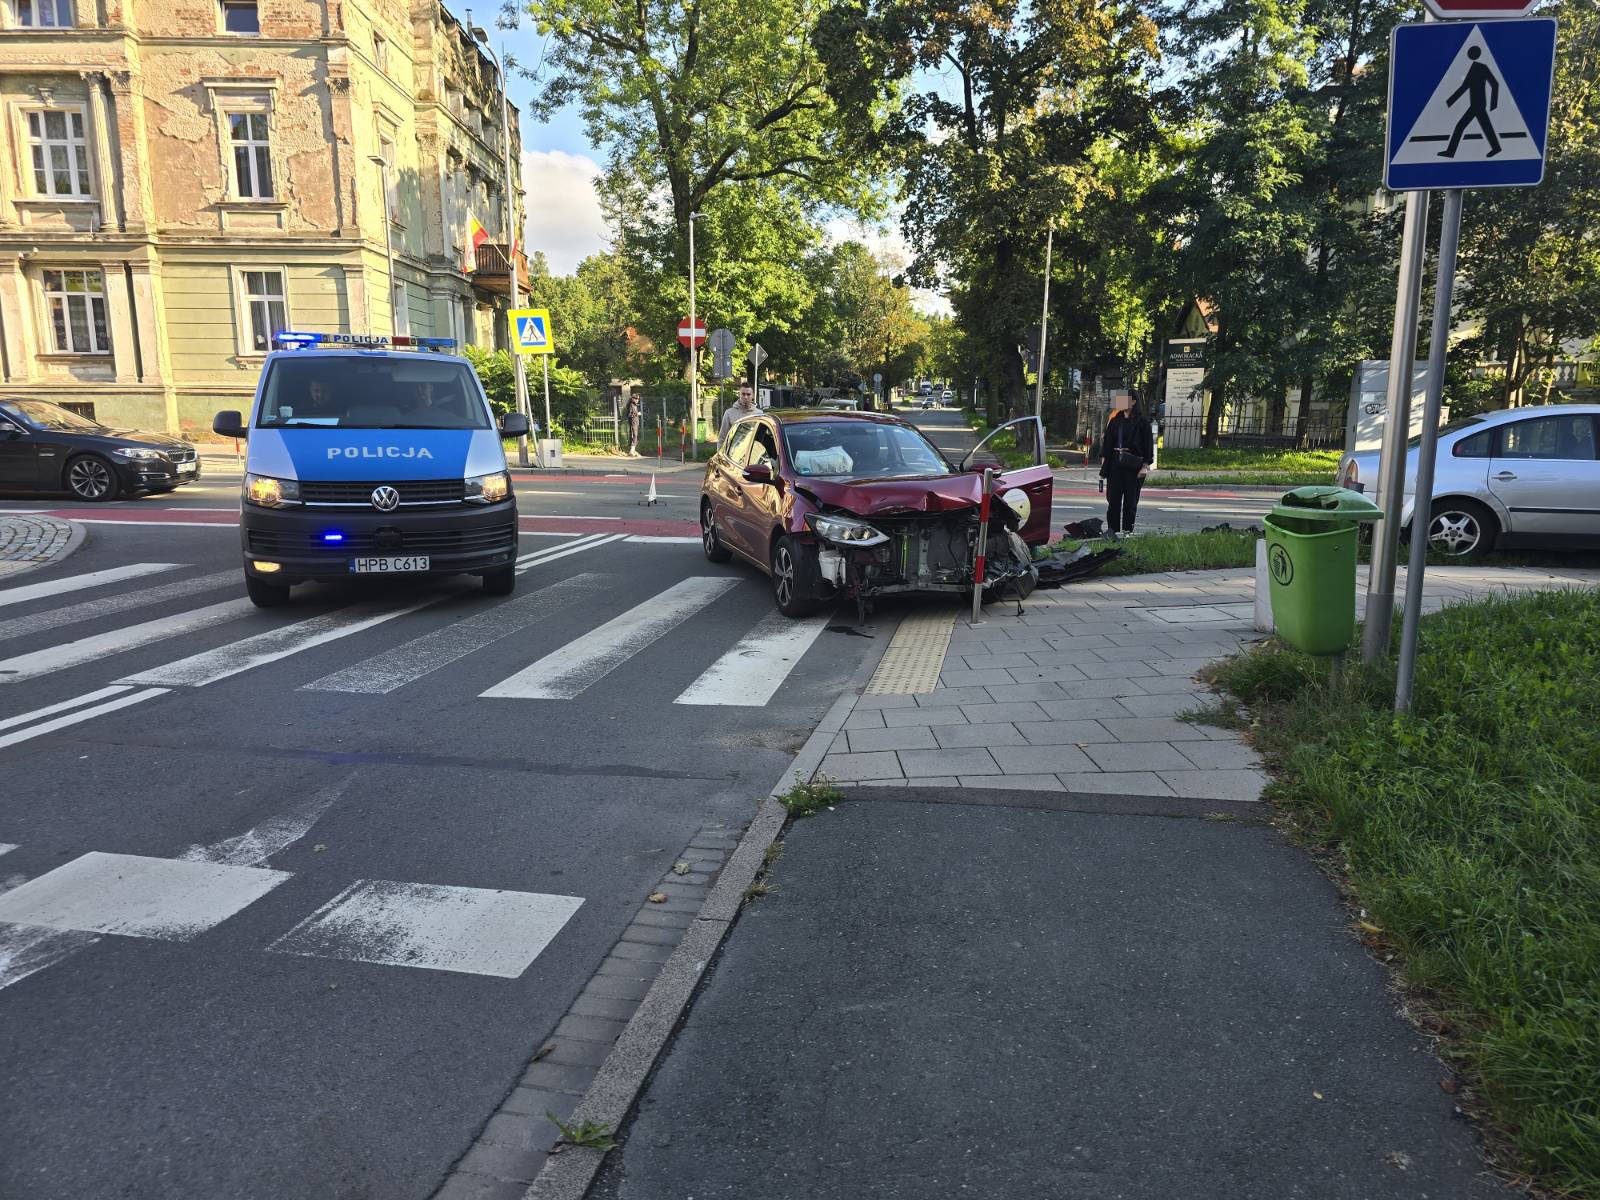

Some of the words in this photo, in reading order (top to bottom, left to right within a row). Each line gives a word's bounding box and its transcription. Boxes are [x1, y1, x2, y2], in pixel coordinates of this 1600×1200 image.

[333, 335, 389, 344] POLICJA
[327, 446, 434, 460] POLICJA
[357, 558, 389, 572] HPB
[393, 557, 428, 571] C613
